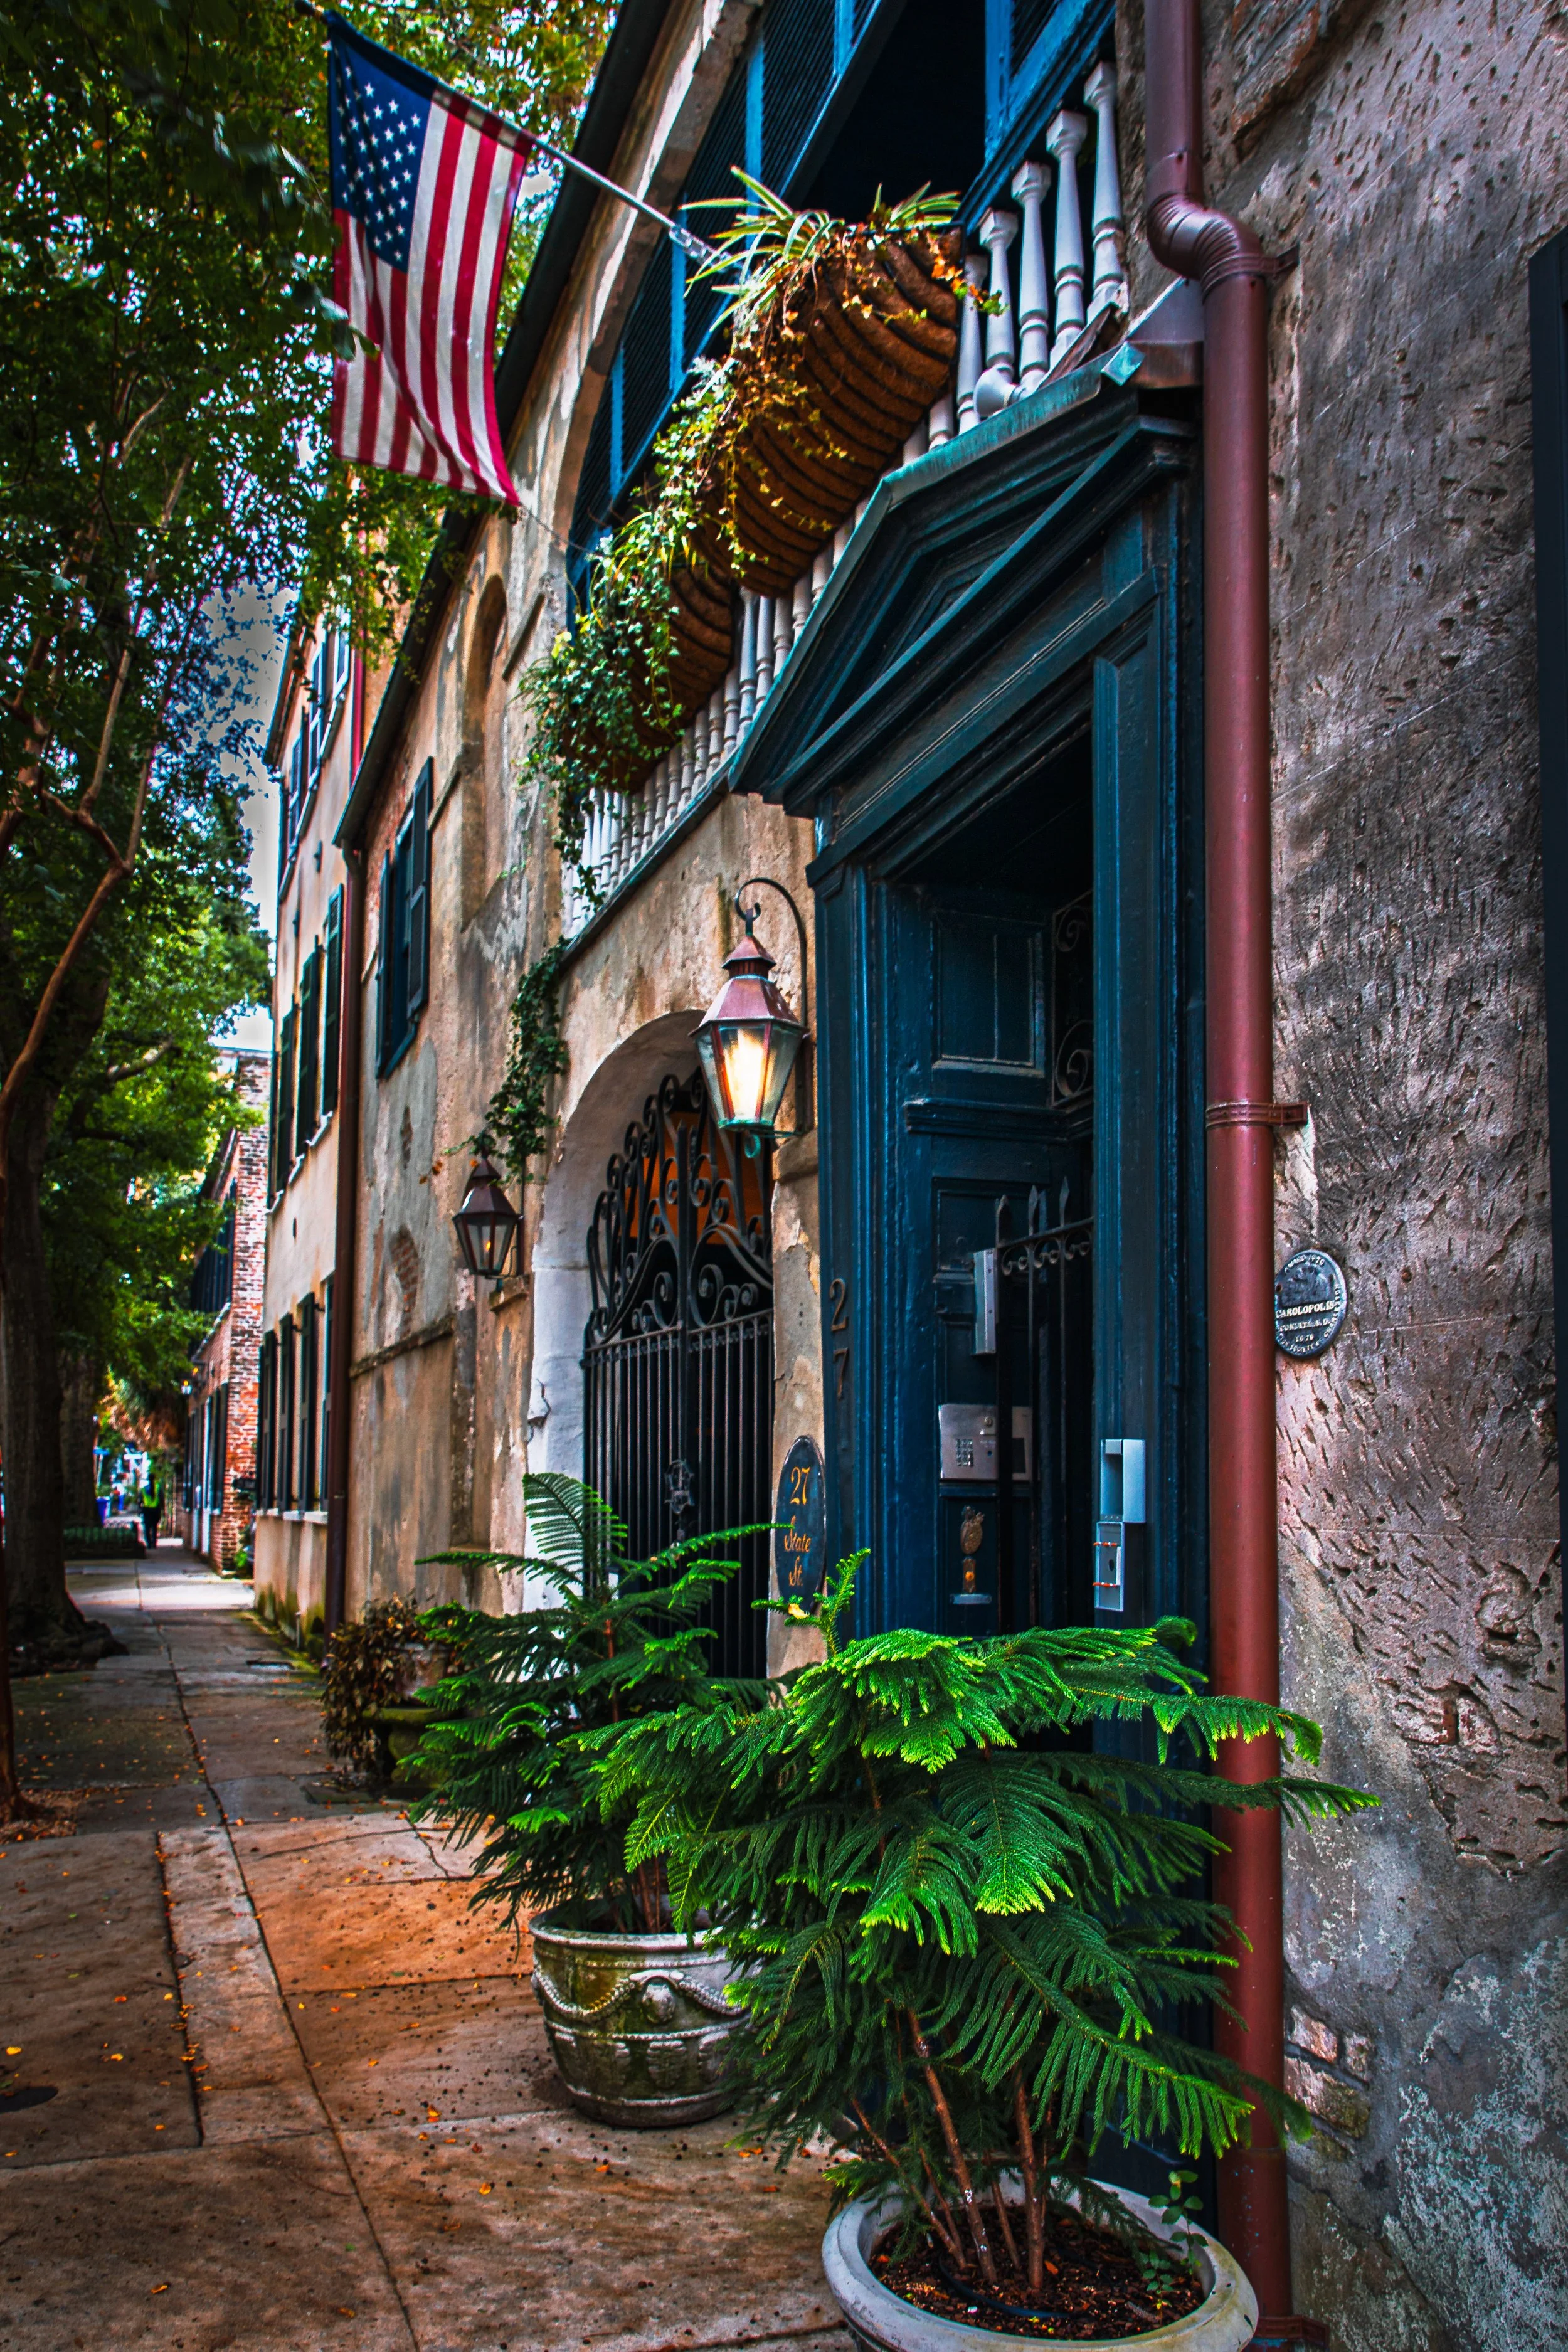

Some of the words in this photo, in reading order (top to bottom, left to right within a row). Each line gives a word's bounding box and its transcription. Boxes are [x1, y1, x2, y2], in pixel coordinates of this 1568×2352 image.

[1276, 1300, 1335, 1318] CAROLOPOLIS
[829, 1278, 848, 1401] 27
[1296, 1333, 1315, 1342] 1670
[790, 1466, 810, 1505] 27
[784, 1515, 812, 1552] State
[788, 1556, 803, 1587] St.
